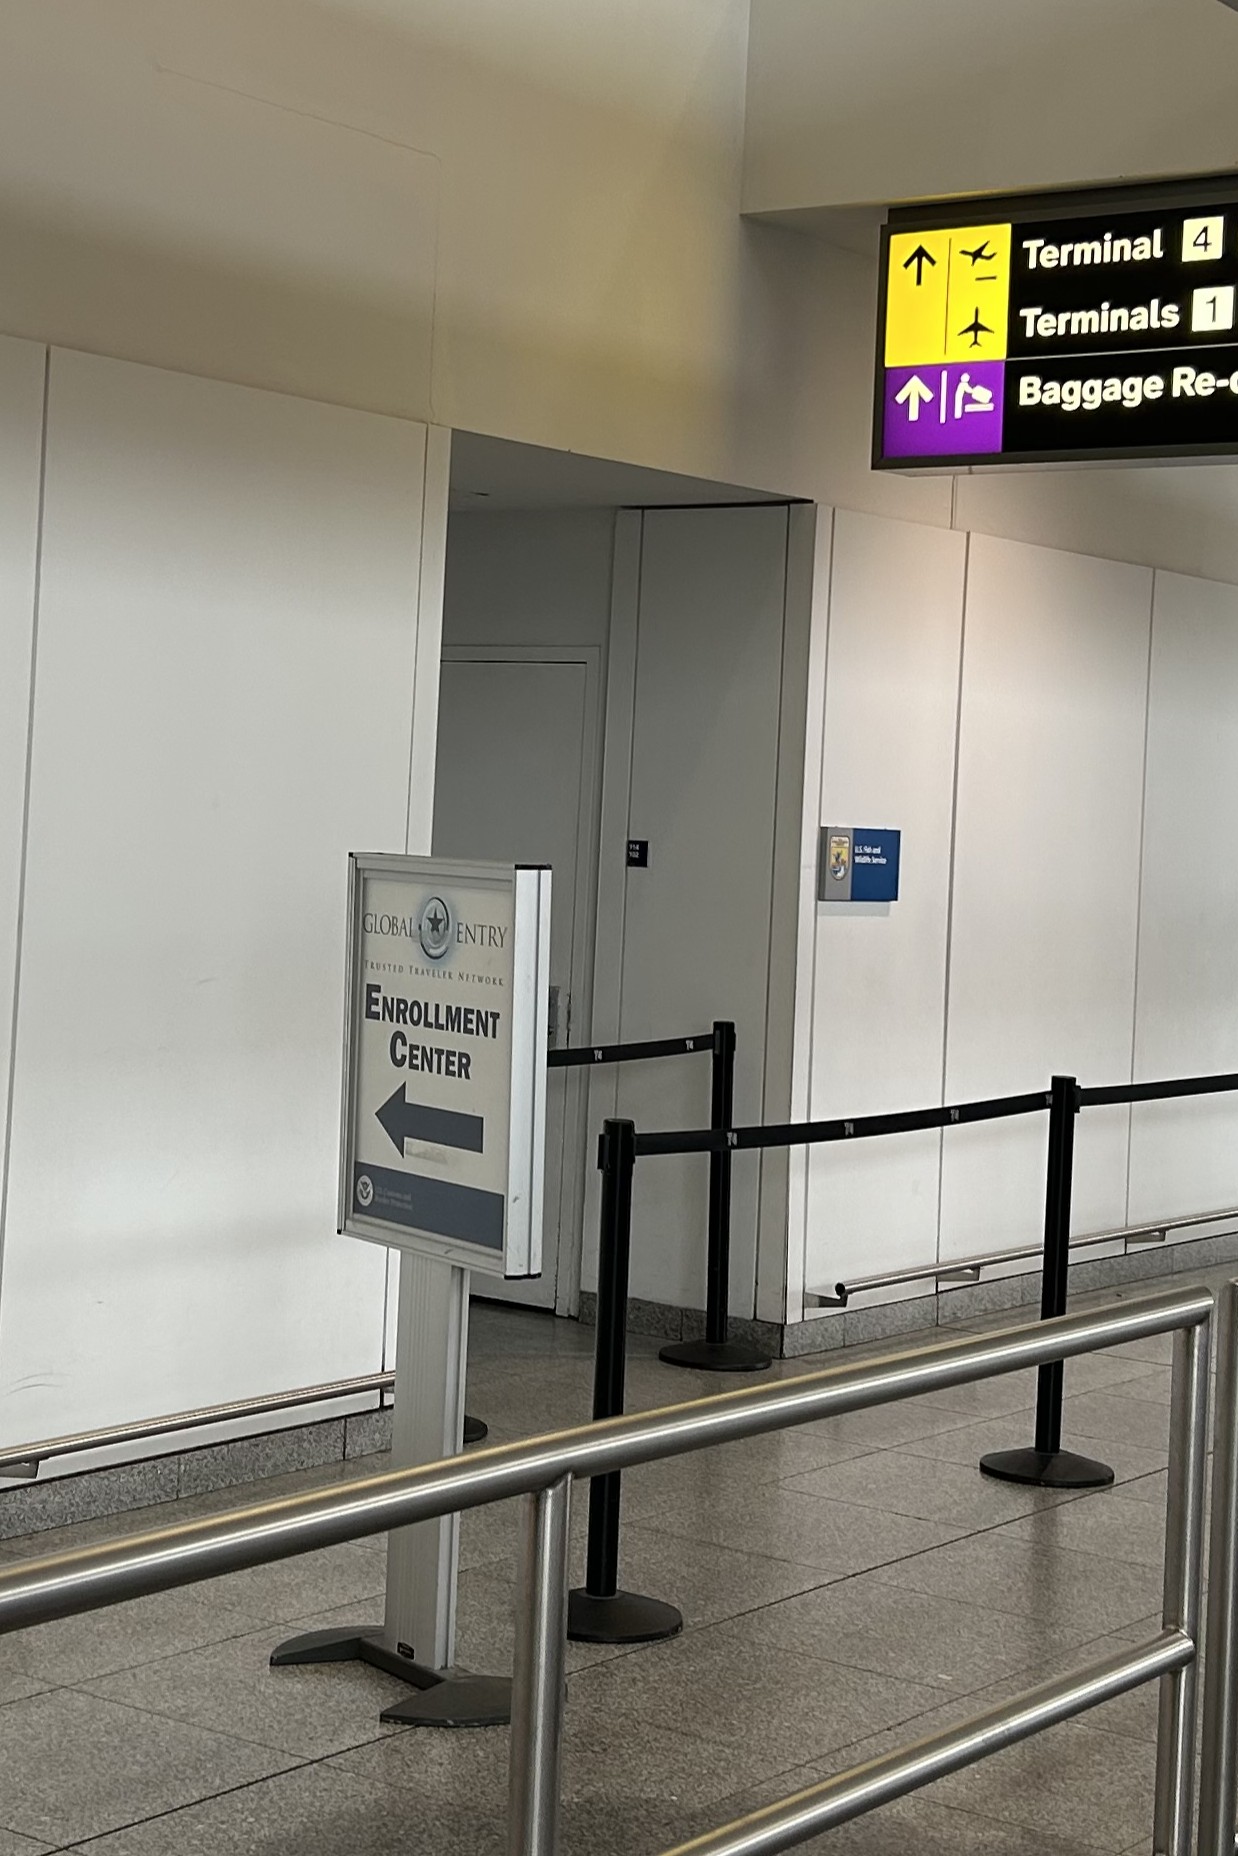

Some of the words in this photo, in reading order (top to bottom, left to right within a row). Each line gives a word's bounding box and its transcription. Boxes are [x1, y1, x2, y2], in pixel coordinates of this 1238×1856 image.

[1022, 229, 1164, 270] Terminal
[1191, 225, 1213, 253] 4
[1018, 299, 1180, 338] Terminals
[1018, 375, 1165, 412] Baggage
[362, 912, 414, 939] GLOBAL
[456, 920, 509, 949] ENTRY
[364, 959, 404, 974] TRUSTED
[409, 965, 453, 980] TRAVELER
[458, 971, 504, 987] NETWORK
[365, 983, 501, 1039] ENROLLMENT
[389, 1030, 472, 1080] CENTER
